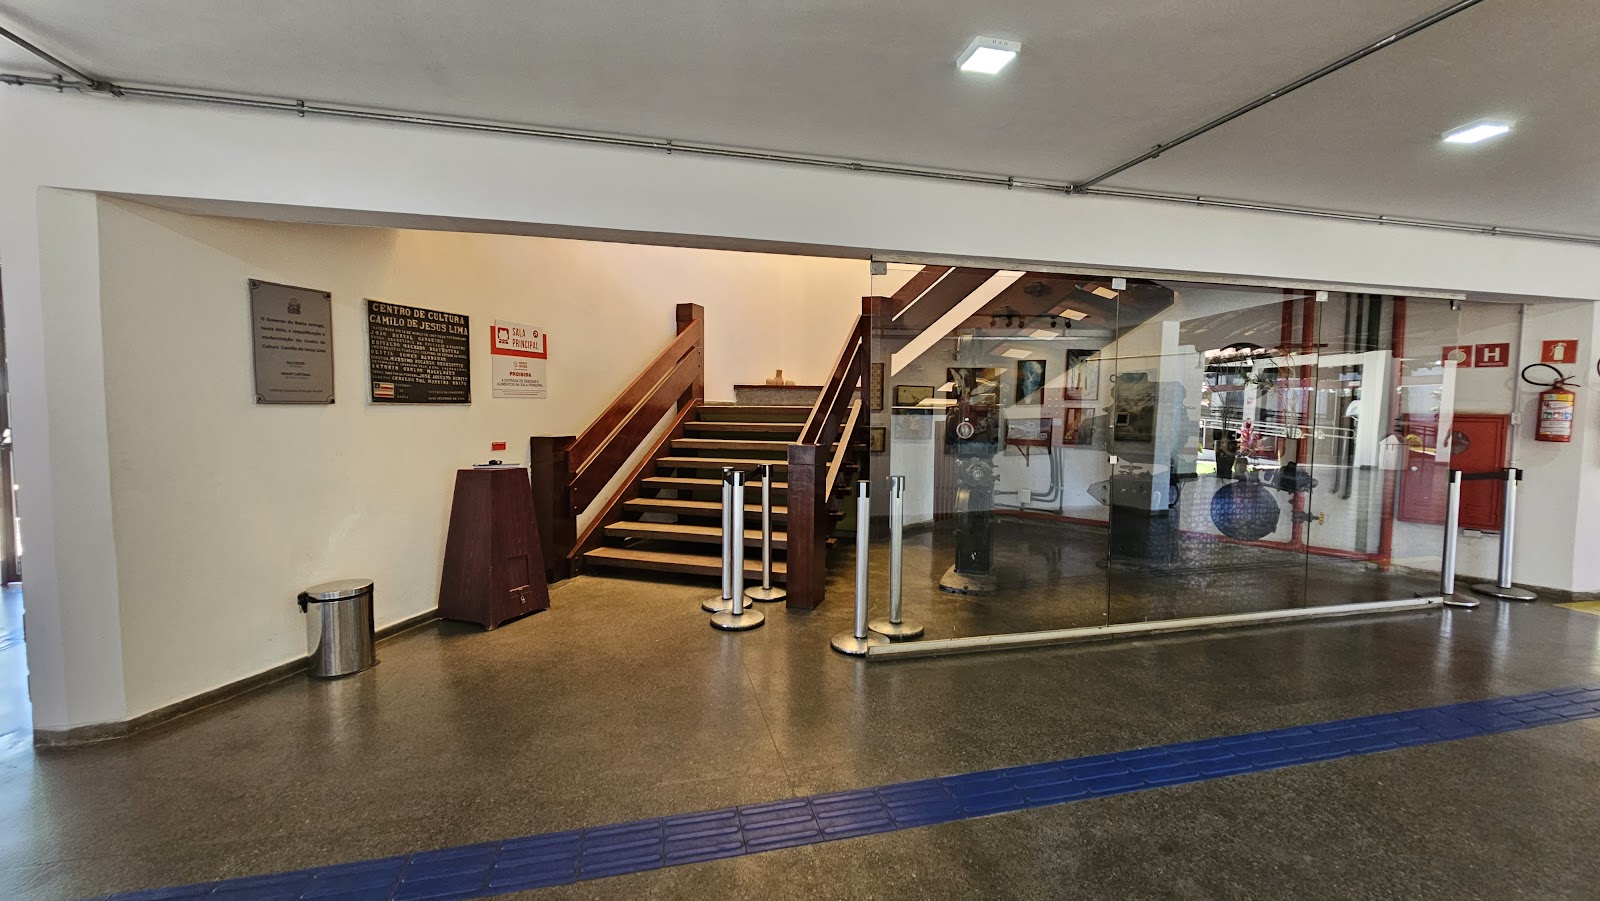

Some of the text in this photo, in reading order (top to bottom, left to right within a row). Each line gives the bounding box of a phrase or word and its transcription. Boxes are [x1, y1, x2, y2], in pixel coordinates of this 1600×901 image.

[373, 303, 464, 324] CENTRO DE CULTURA
[370, 315, 468, 335] CAMILO DE JESUS LIMA
[512, 328, 526, 337] SALA
[512, 338, 538, 350] PRINCIPAL
[1484, 348, 1500, 362] H
